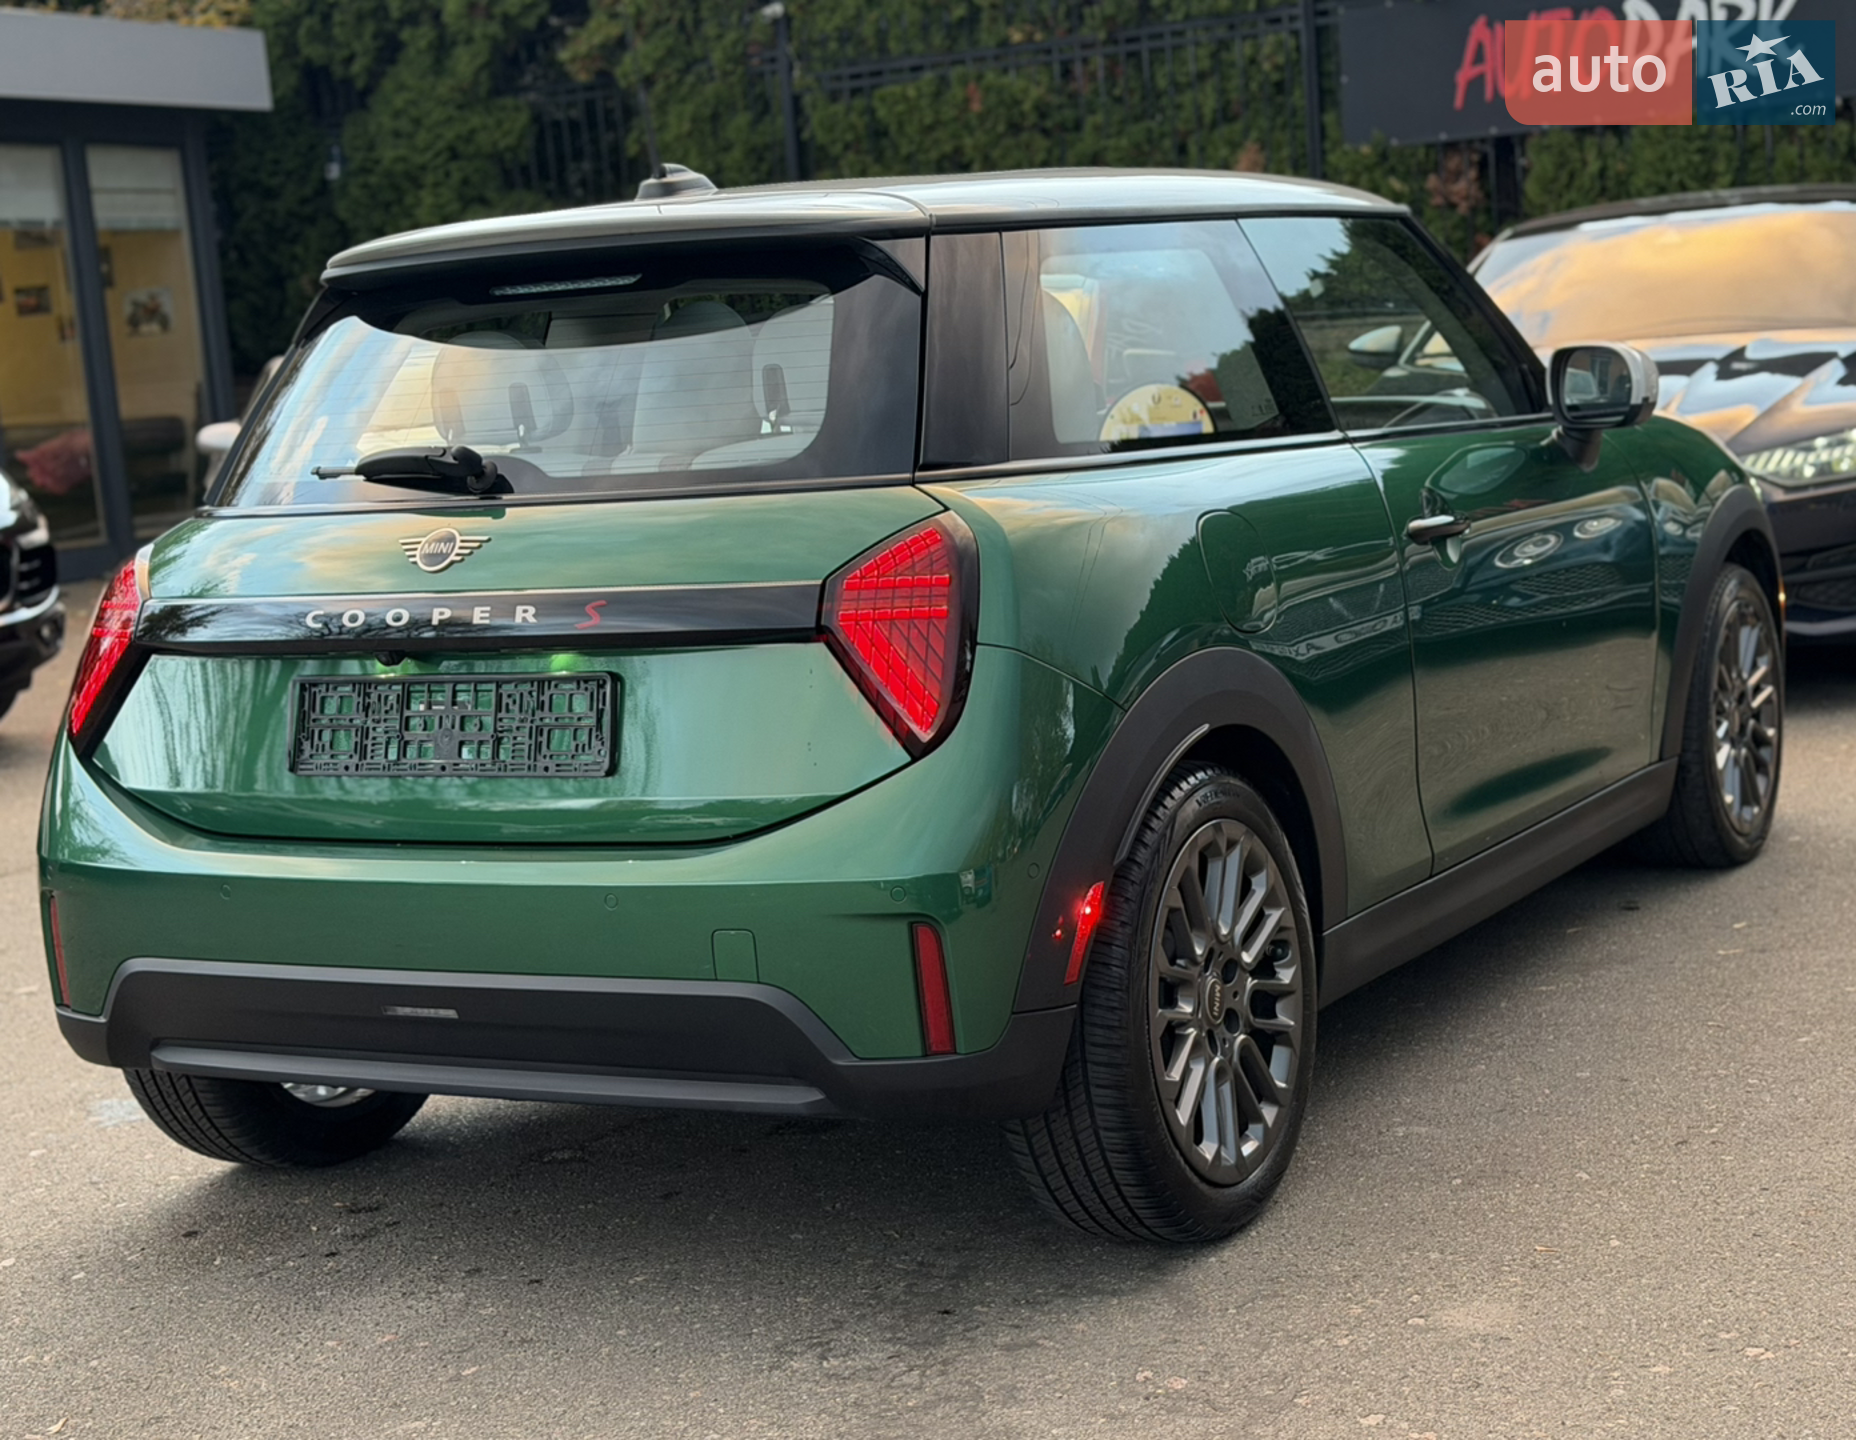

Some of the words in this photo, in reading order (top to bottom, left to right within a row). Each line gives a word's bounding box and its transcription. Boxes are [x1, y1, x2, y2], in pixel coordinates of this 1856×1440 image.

[421, 541, 455, 555] MINI
[305, 605, 538, 629] COOPER
[574, 600, 607, 629] S
